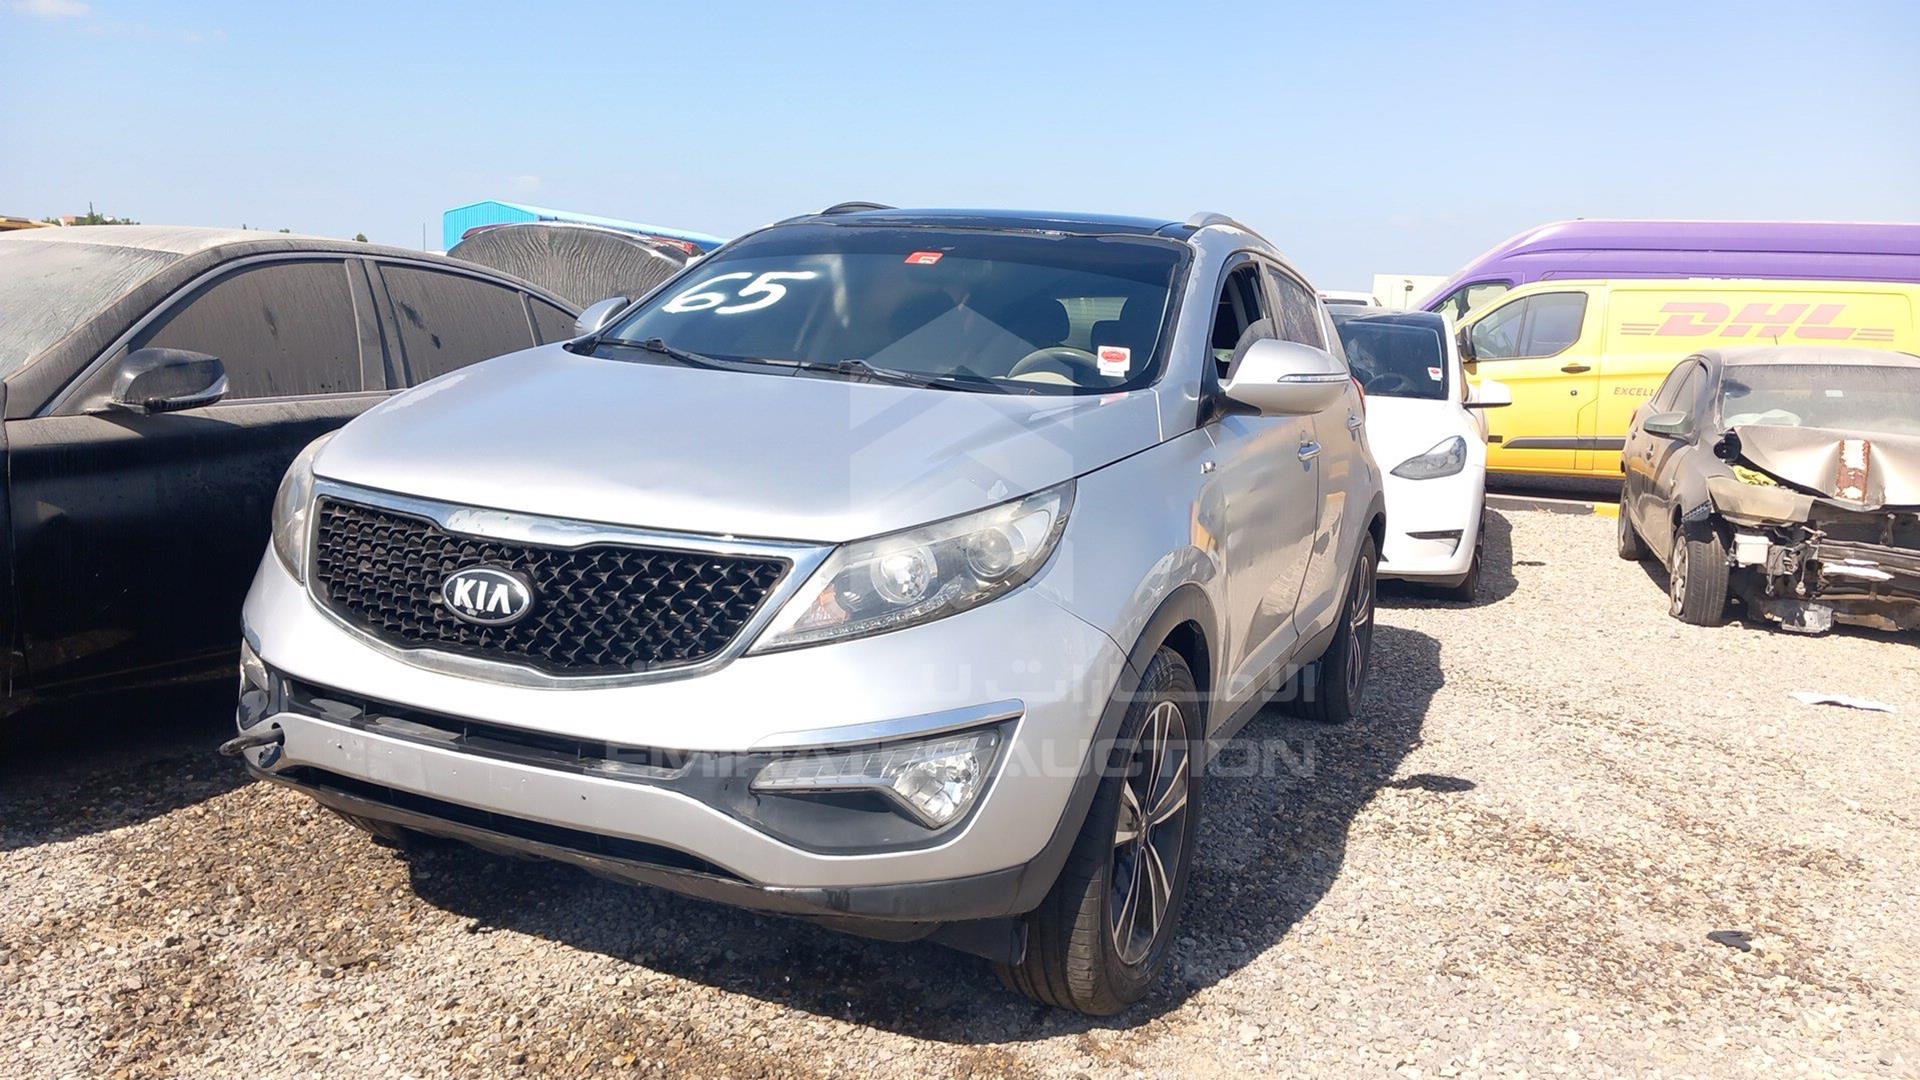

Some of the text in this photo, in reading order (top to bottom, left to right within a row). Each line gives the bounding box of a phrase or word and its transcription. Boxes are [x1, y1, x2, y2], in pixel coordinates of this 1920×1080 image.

[662, 272, 816, 314] 65
[1655, 302, 1857, 340] DHL
[453, 578, 511, 614] KIA
